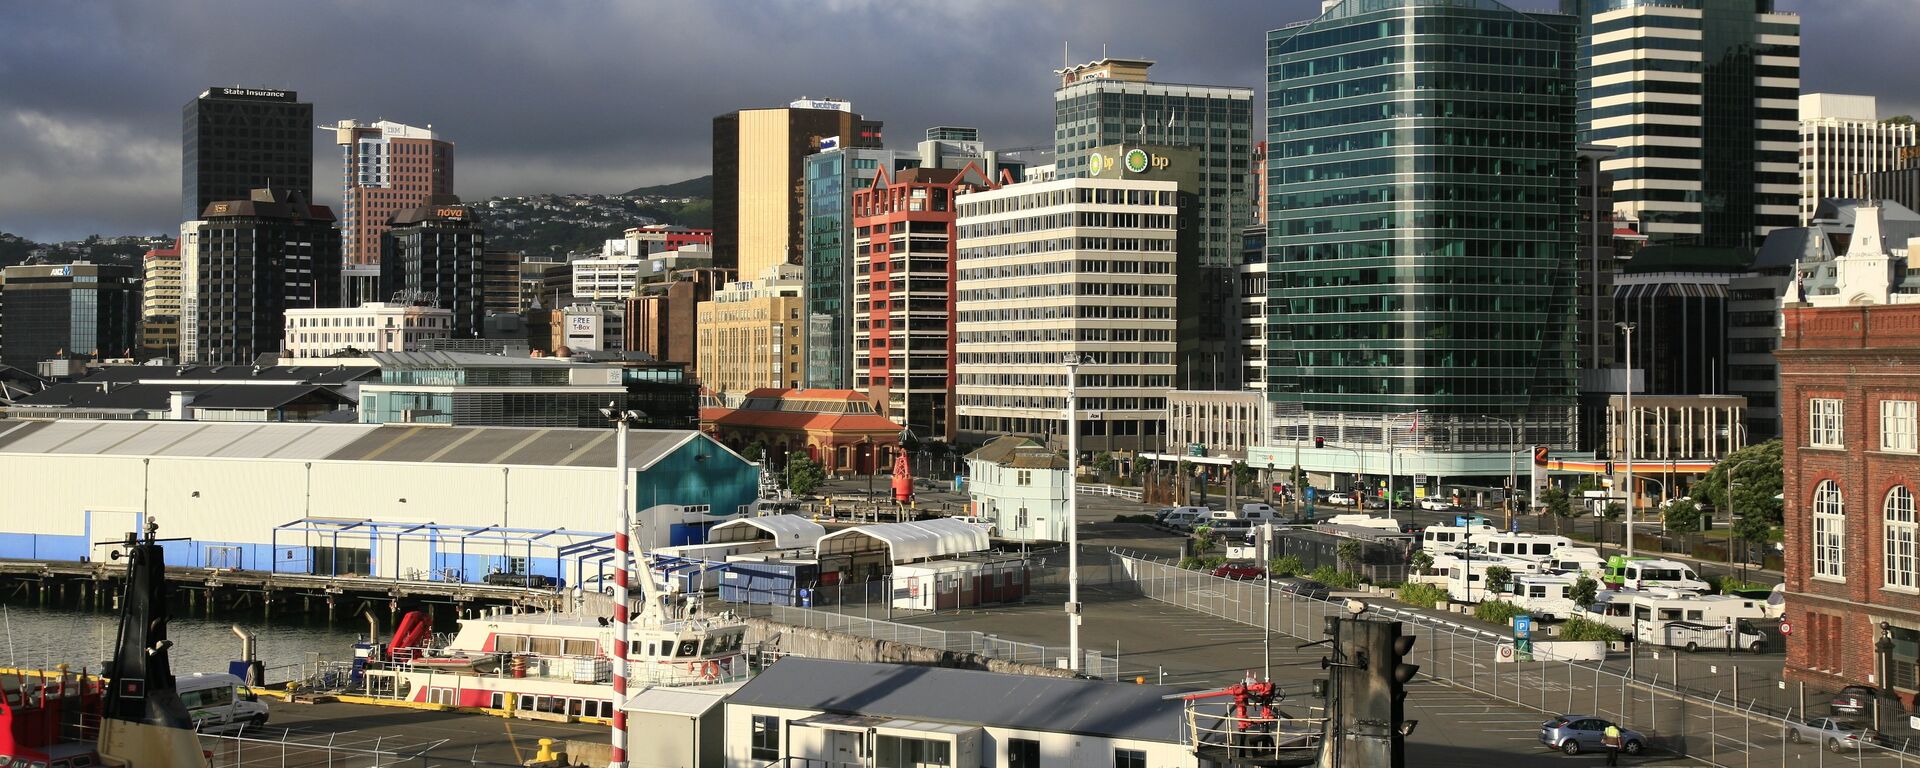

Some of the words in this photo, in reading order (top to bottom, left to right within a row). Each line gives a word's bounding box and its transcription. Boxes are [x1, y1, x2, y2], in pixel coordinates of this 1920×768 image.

[246, 89, 285, 97] Insurance
[1103, 155, 1114, 170] bp
[1151, 153, 1169, 170] bp
[437, 208, 463, 217] nova
[50, 268, 64, 276] ANZ
[735, 281, 753, 292] TOWER
